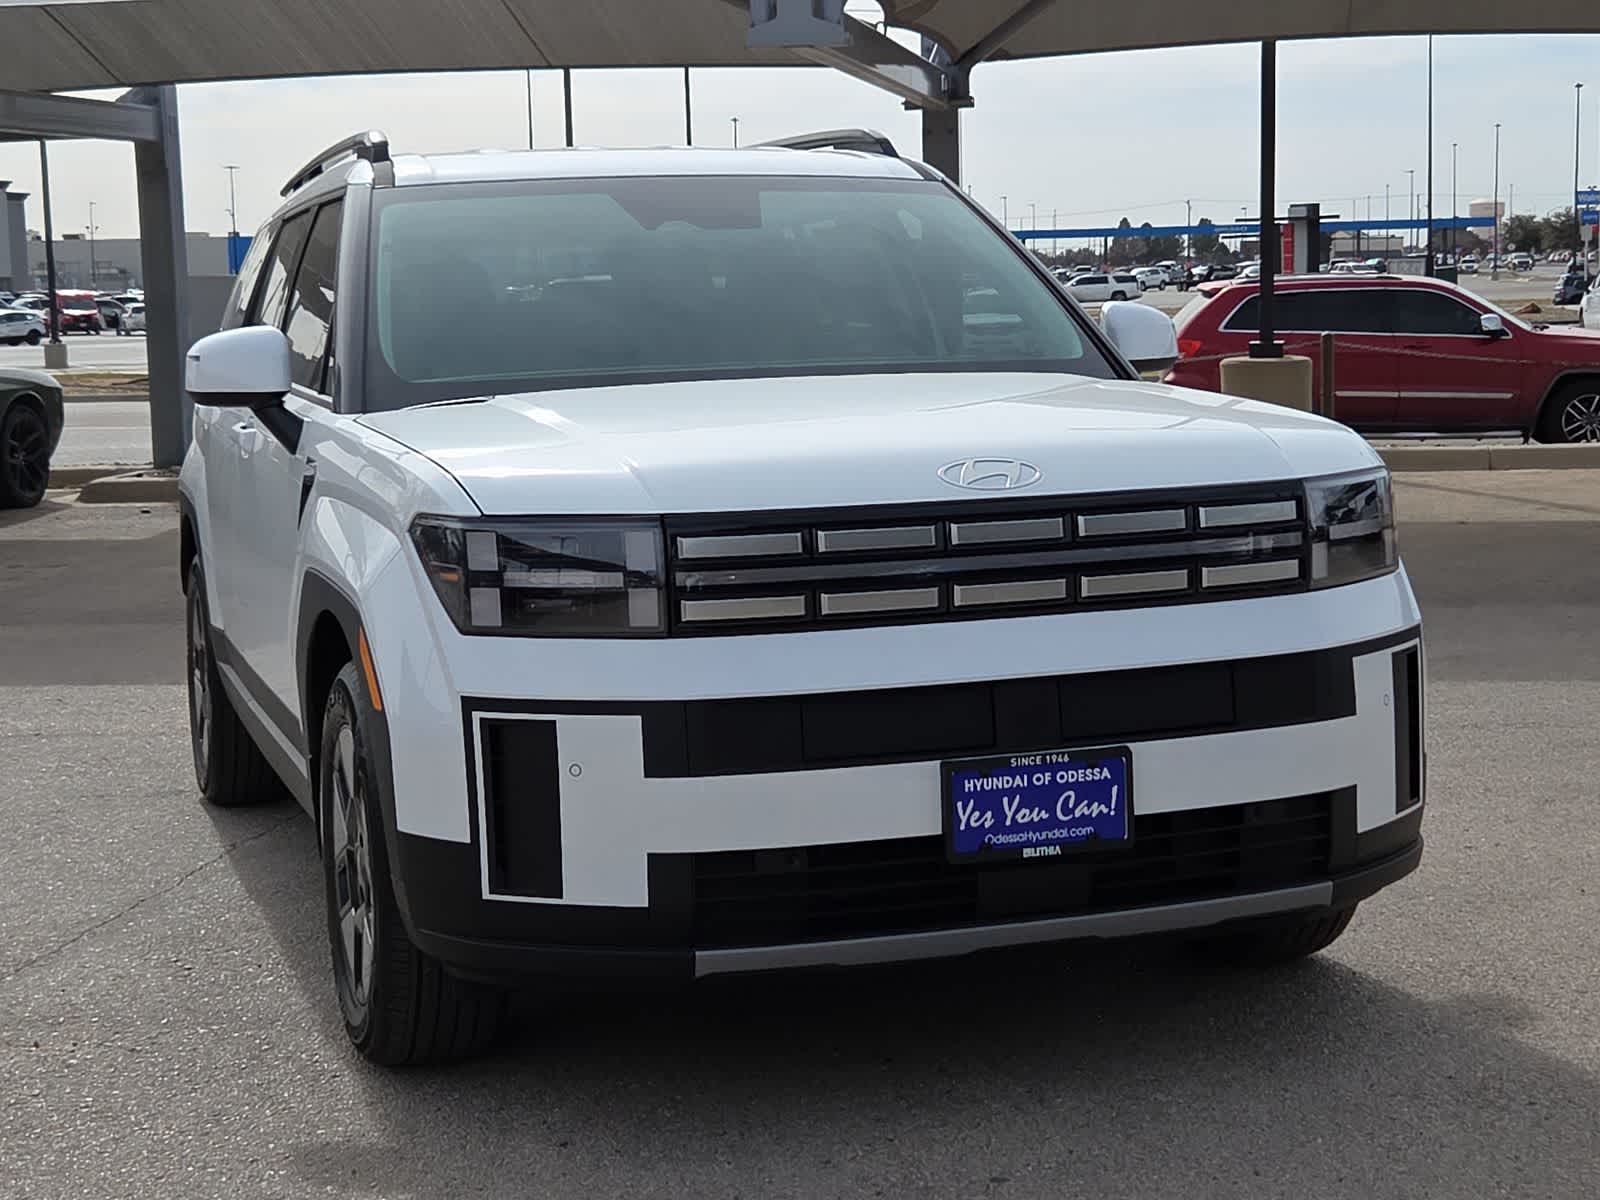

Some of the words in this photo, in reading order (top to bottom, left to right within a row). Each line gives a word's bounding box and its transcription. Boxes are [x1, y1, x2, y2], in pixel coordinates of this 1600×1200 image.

[1010, 757, 1042, 767] SINCE
[1046, 755, 1070, 764] 1946
[964, 774, 1028, 792] HYUNDAI
[1032, 773, 1052, 786] OF
[1056, 767, 1111, 782] ODESSA
[957, 799, 994, 831] Yes
[1002, 794, 1049, 827] You
[1056, 785, 1118, 821] Can!
[985, 827, 1095, 845] OdessaHyundai.com
